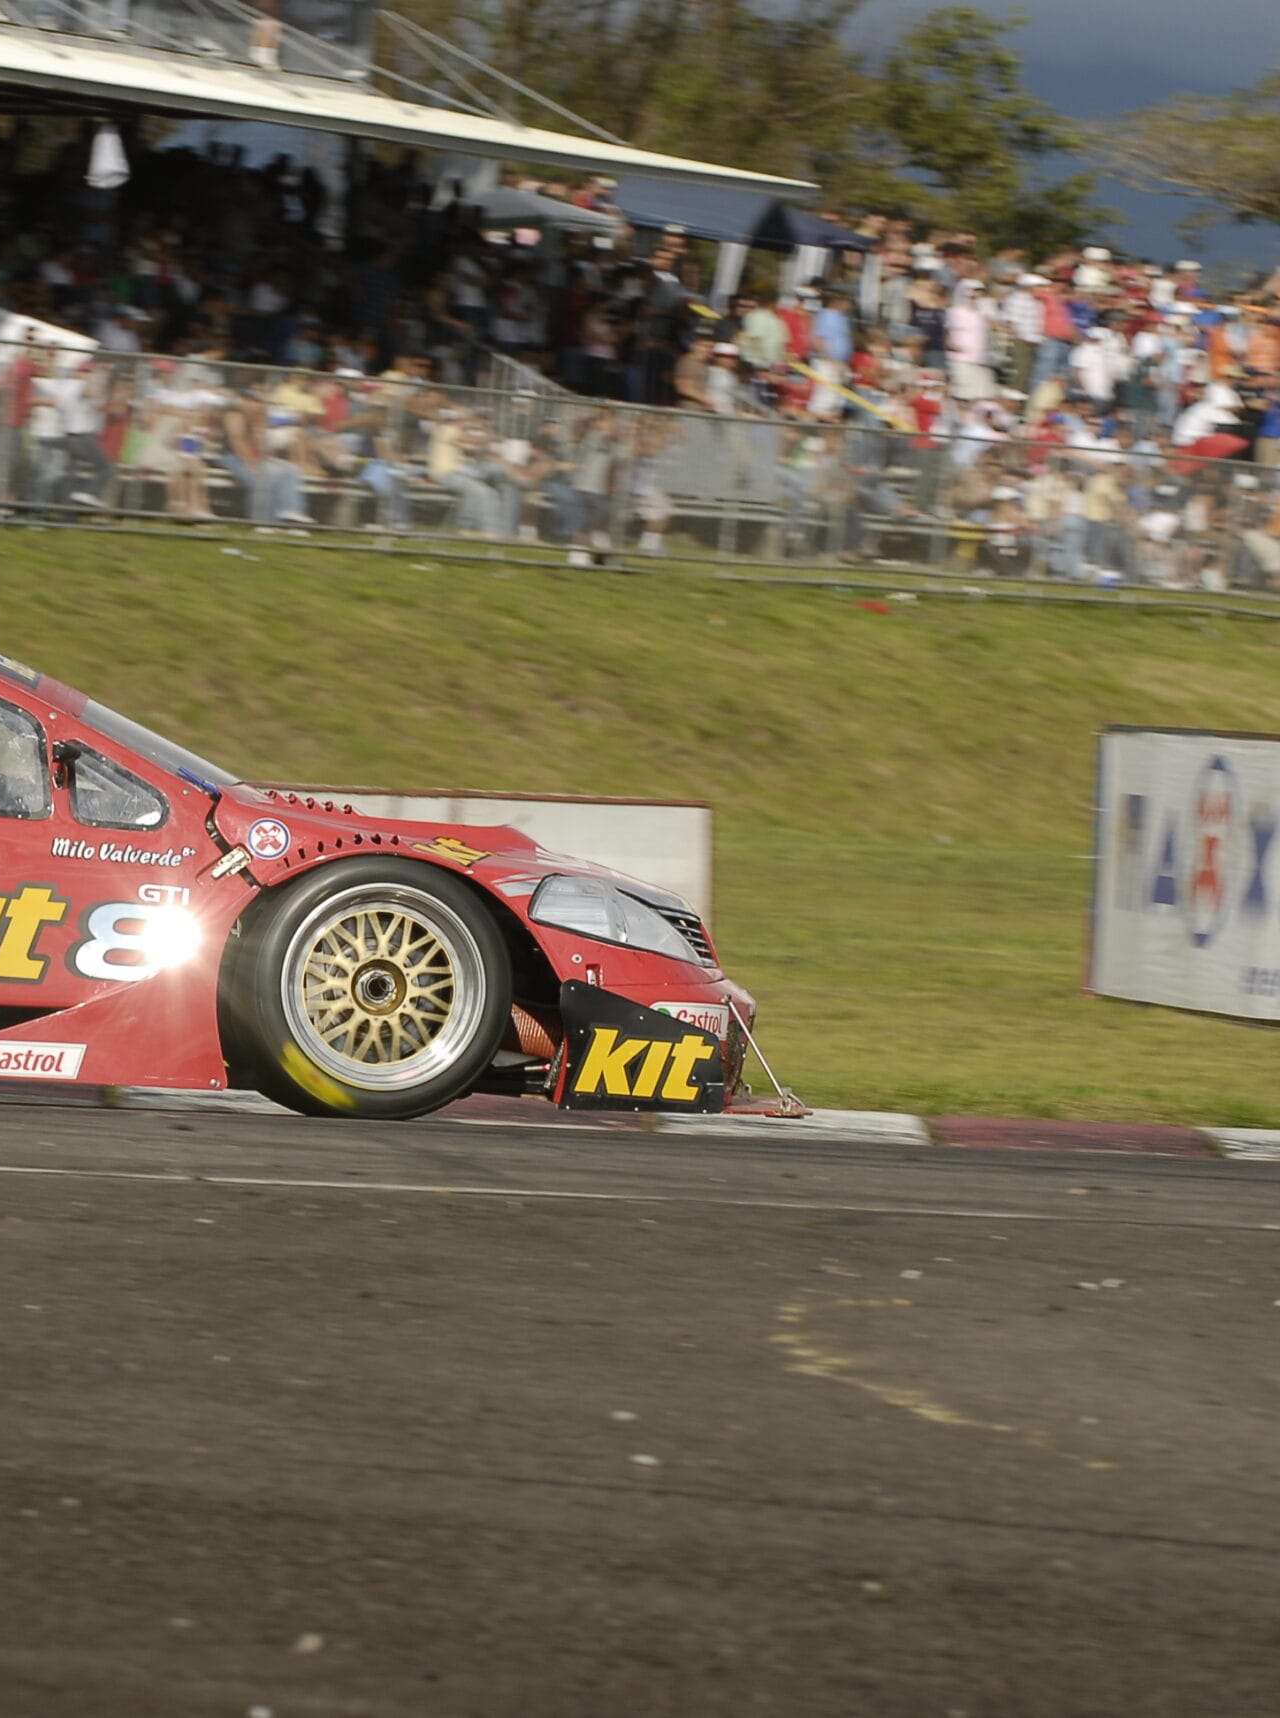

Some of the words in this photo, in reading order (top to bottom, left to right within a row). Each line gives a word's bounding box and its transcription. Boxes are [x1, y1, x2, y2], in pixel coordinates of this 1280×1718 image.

[51, 837, 95, 859] Milo
[98, 843, 182, 867] Valverde
[137, 883, 190, 905] GTI
[74, 902, 202, 983] 8
